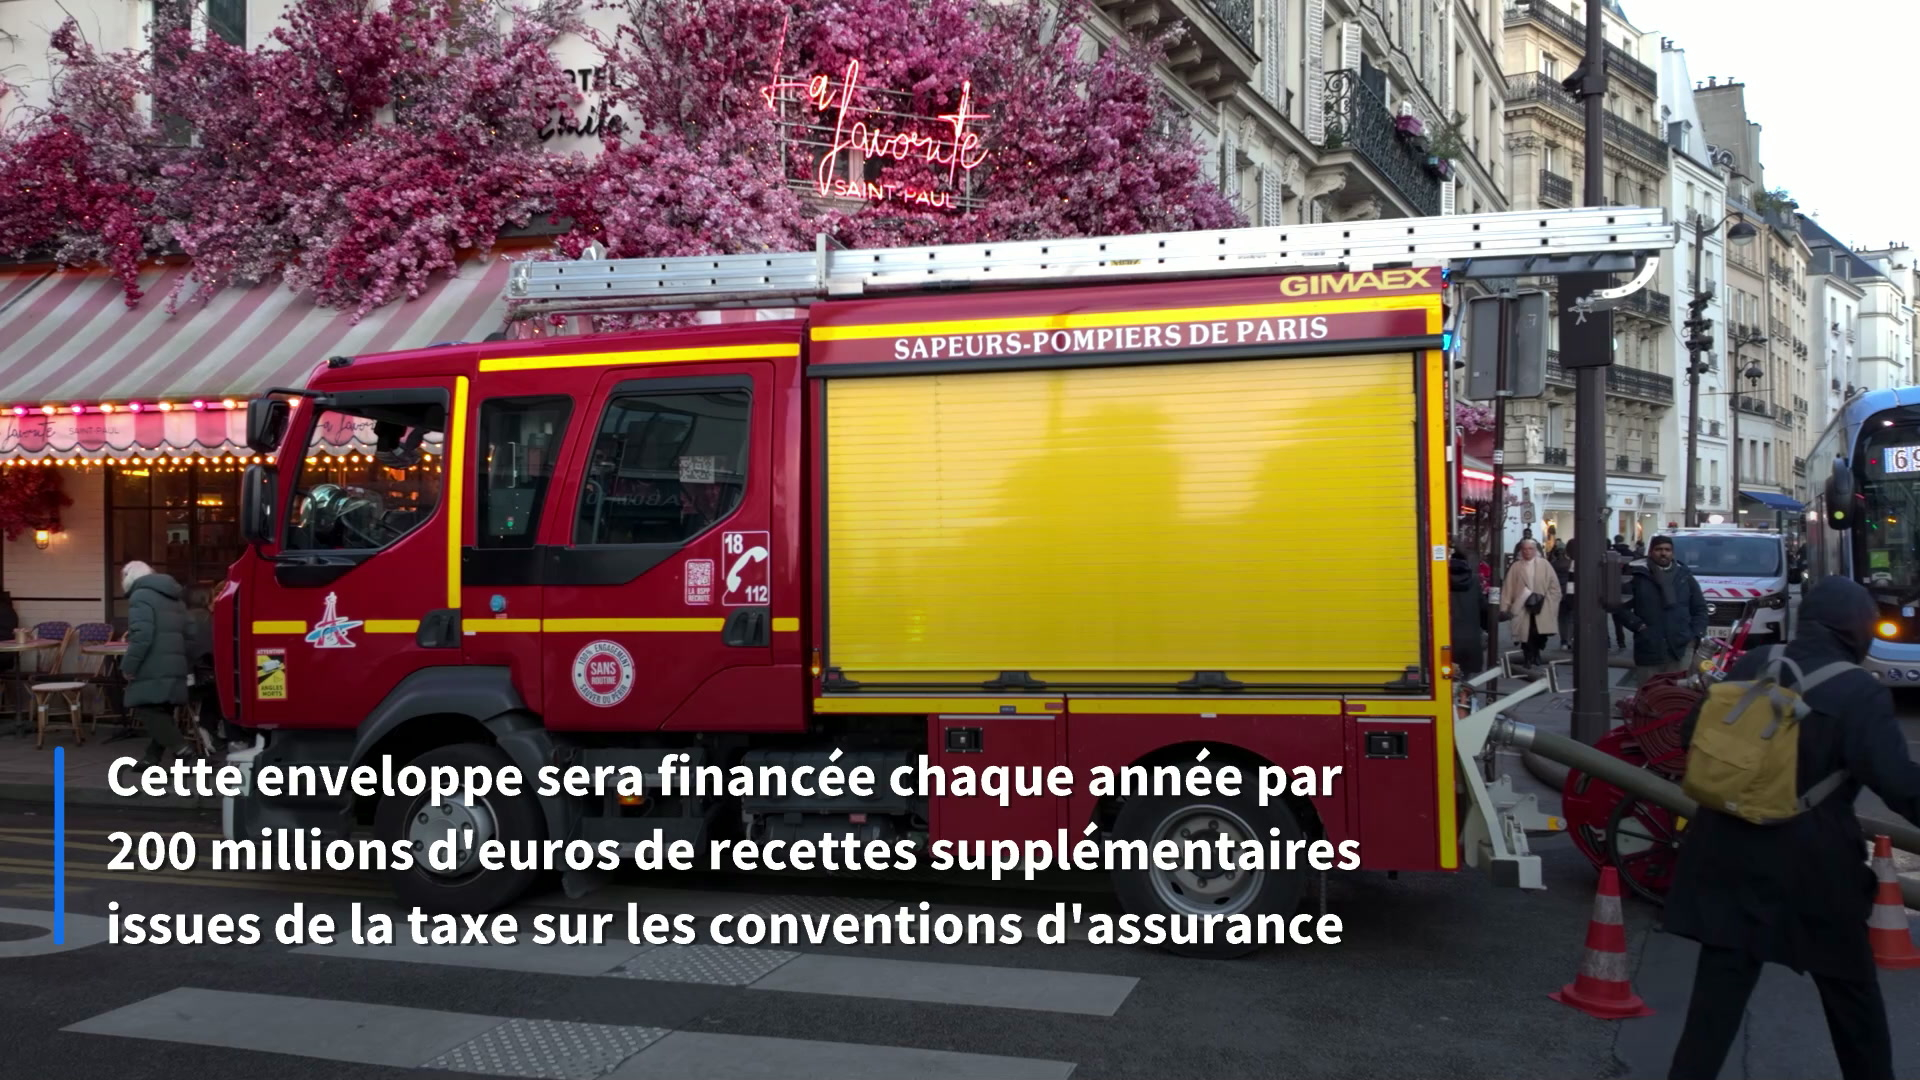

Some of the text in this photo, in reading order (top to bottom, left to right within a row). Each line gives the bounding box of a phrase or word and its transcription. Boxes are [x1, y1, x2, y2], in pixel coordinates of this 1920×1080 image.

[819, 59, 991, 197] favorite
[834, 180, 957, 210] SAINT-PAUL
[1280, 268, 1431, 296] GIMAEX
[894, 317, 1329, 360] SAPEURS-POMPIERS DE PARIS
[724, 533, 744, 554] 18
[745, 585, 768, 602] 112
[578, 643, 630, 668] 100% ENGAGEMENT
[590, 661, 617, 675] SANS
[580, 683, 601, 703] SAUVER
